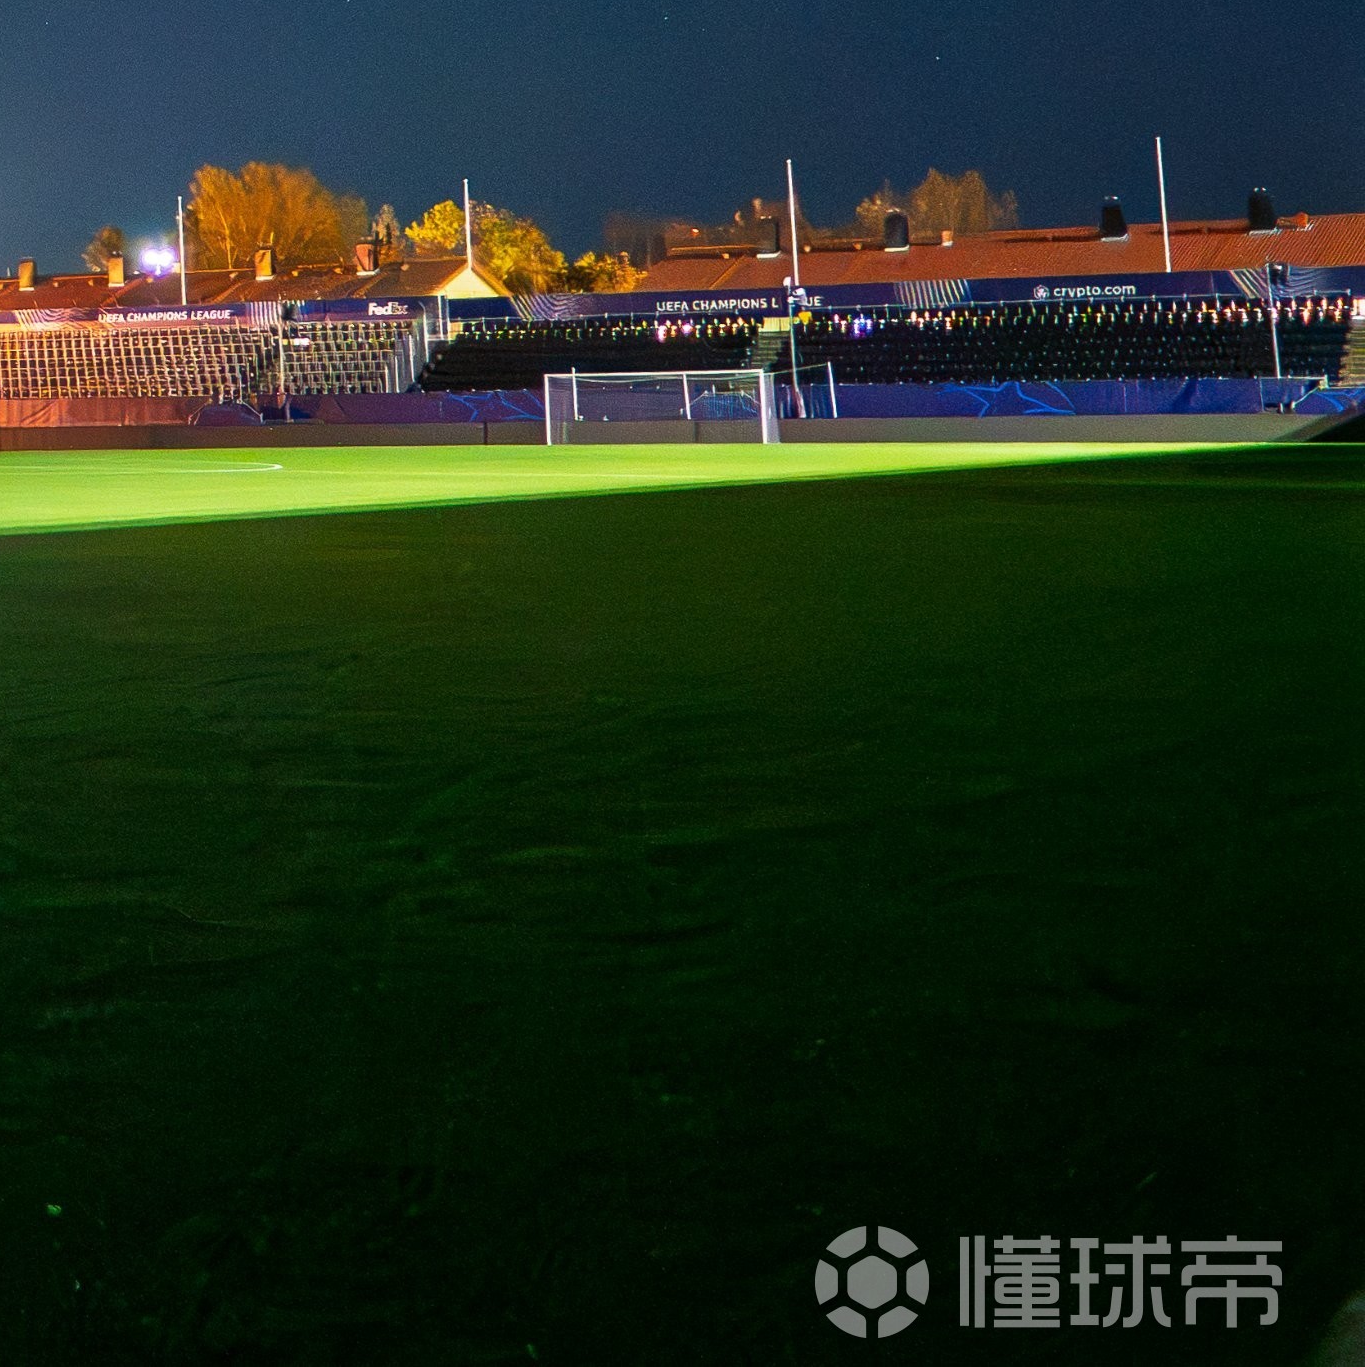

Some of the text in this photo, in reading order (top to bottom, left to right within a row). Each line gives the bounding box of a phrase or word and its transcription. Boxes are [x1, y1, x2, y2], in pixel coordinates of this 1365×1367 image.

[1053, 285, 1135, 297] crypto.com
[368, 301, 408, 315] FedEx
[656, 296, 822, 312] UEFA CHAMPIONS LUE
[98, 309, 231, 323] UEFA CHAMPIONS LEAGUE
